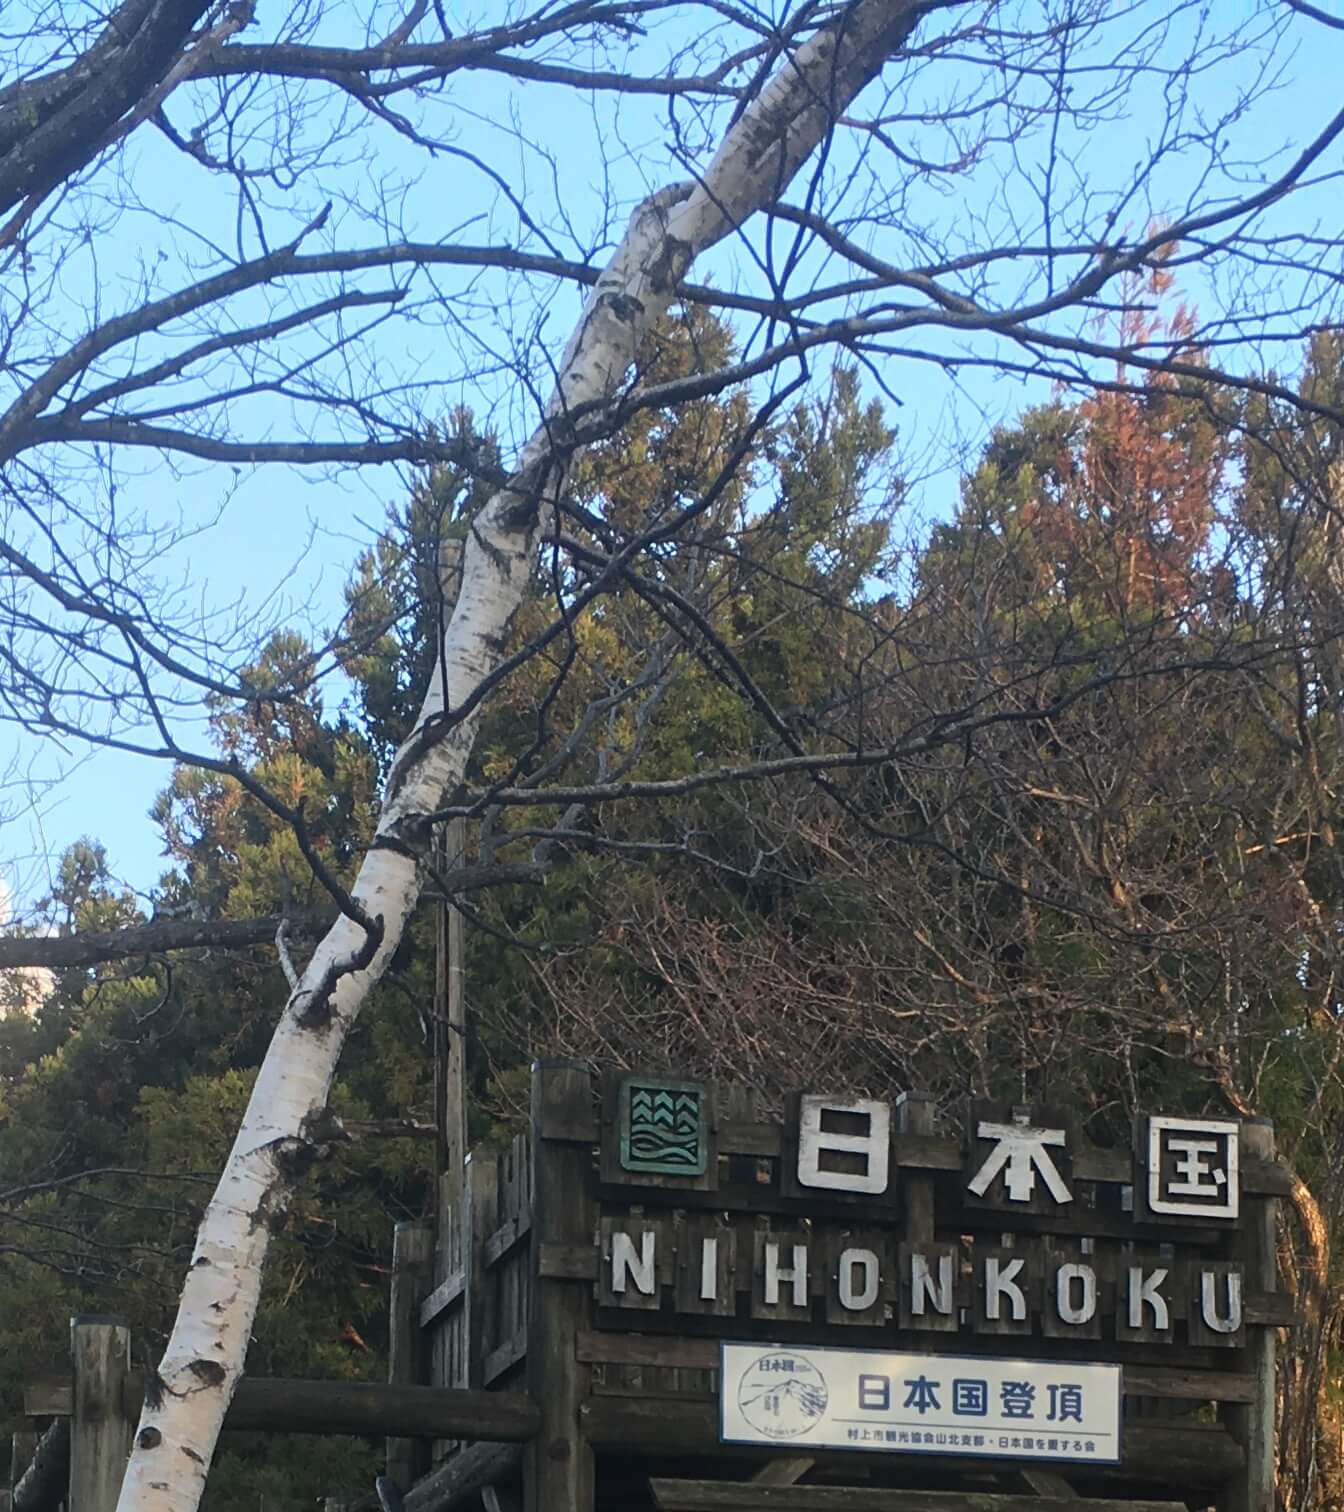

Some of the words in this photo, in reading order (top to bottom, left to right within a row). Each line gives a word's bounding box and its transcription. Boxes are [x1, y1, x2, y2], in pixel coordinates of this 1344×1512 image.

[798, 1094, 1240, 1219] 日本国
[610, 1231, 1243, 1334] NIHONKOKU
[857, 1374, 1085, 1424] 日本国登頂
